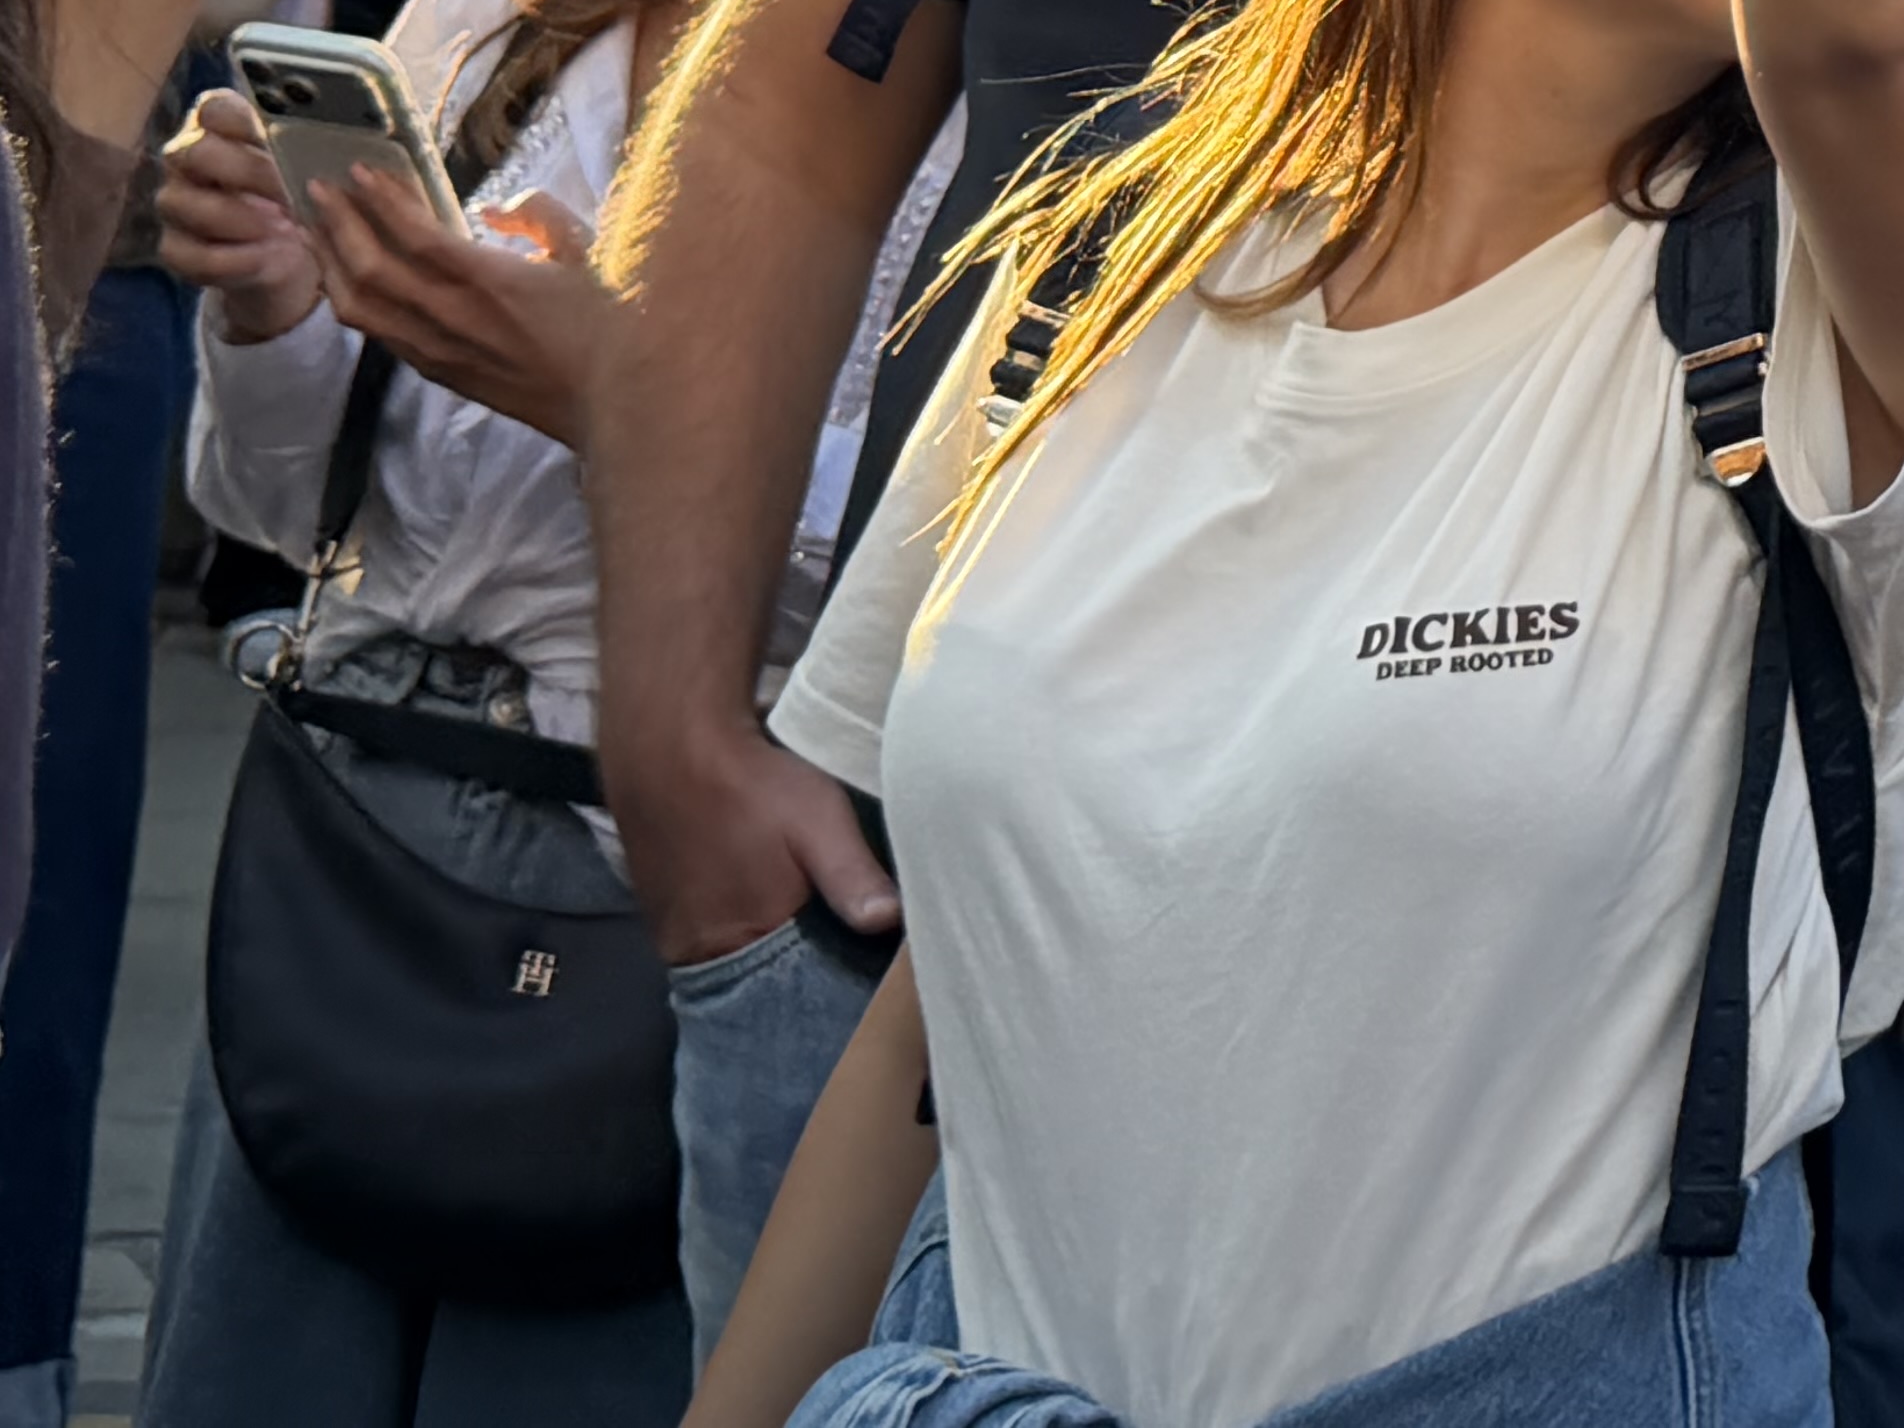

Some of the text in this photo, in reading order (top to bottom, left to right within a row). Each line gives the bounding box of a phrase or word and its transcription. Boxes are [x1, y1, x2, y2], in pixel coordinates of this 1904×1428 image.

[1356, 601, 1581, 660] DICKIES
[1375, 647, 1555, 681] DEEP ROOTED
